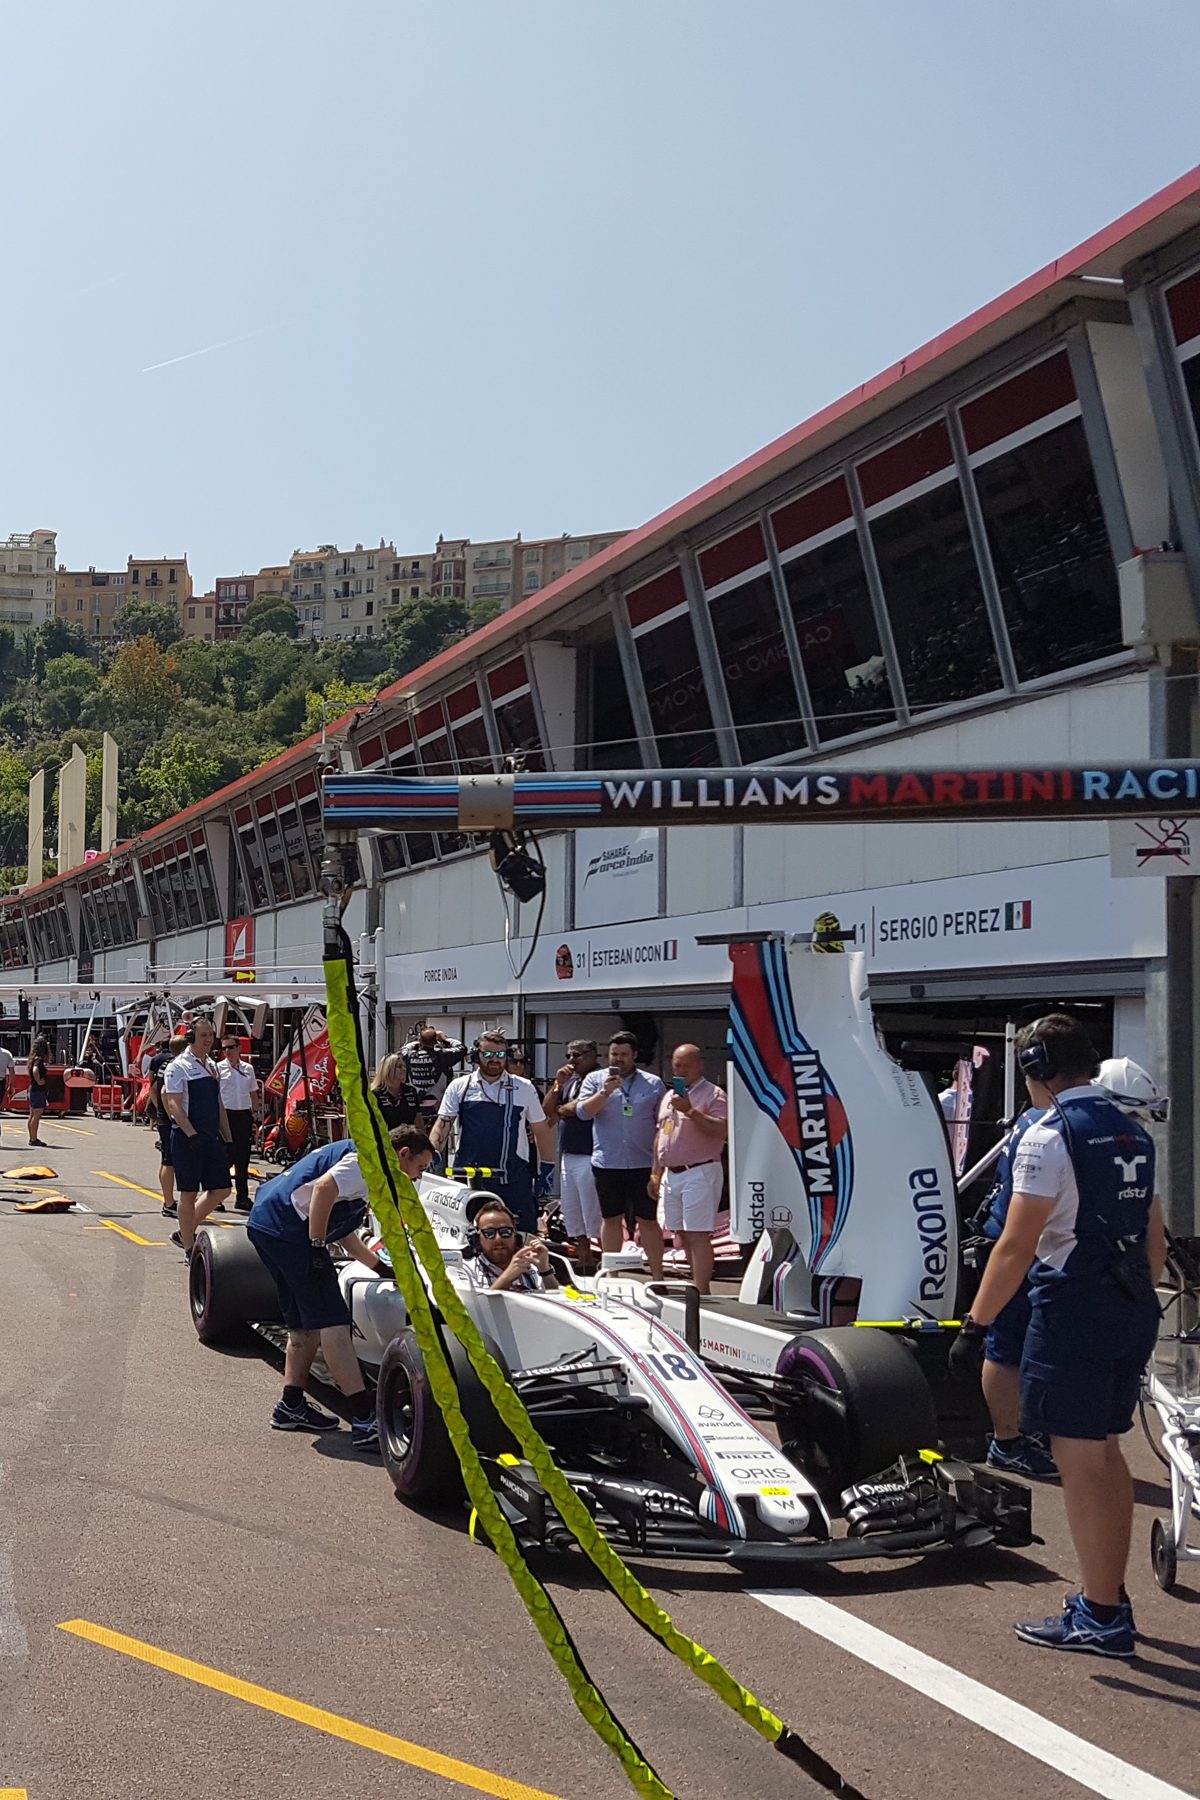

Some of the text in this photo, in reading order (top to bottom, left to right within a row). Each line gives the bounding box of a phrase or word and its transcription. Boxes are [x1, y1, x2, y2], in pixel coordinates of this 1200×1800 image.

[604, 768, 1200, 808] WILLIAMS MARTINI RACI
[880, 915, 938, 942] SERGIO
[944, 908, 1000, 936] PEREZ
[576, 944, 662, 968] 31 ESTEBAN OCON
[424, 968, 458, 982] FORCE INDIA
[792, 1054, 834, 1192] MARTINI
[909, 1167, 950, 1302] Rexona
[646, 1353, 698, 1381] 18
[708, 1341, 740, 1359] MARTINI
[742, 1350, 772, 1368] RACING
[730, 1468, 791, 1480] ORIS
